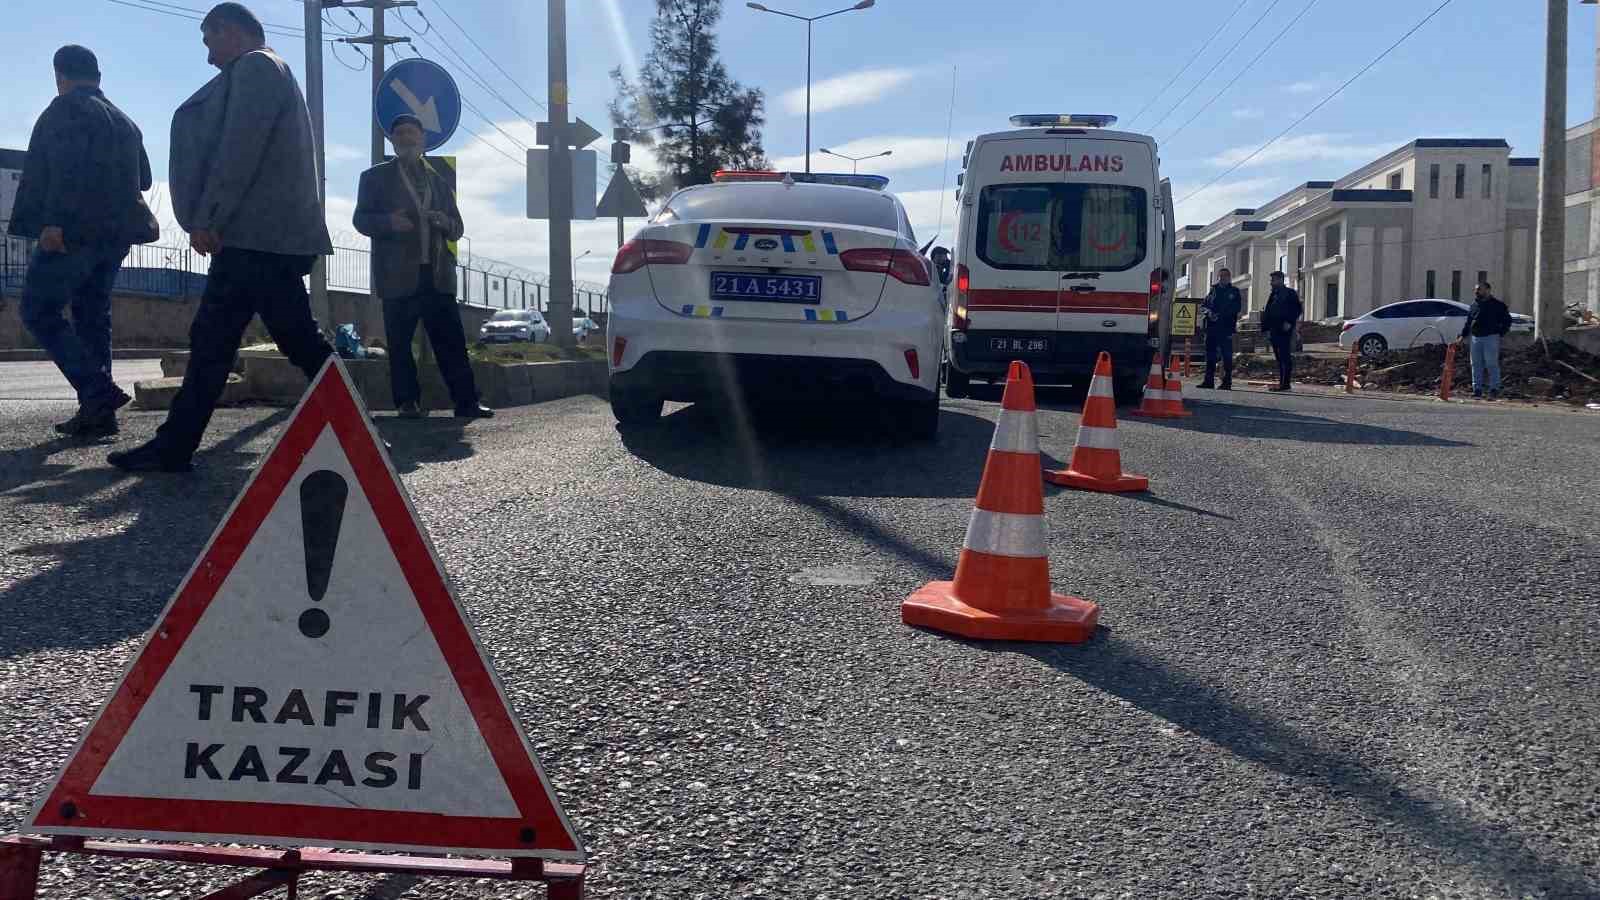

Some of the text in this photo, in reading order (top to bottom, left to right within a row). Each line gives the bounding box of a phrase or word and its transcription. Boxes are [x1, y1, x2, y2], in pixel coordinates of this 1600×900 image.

[1000, 154, 1124, 172] AMBULANS
[1010, 224, 1041, 241] 112
[716, 276, 817, 297] 21 A 5431
[190, 684, 431, 731] TRAFIK
[184, 742, 424, 790] KAZASI
